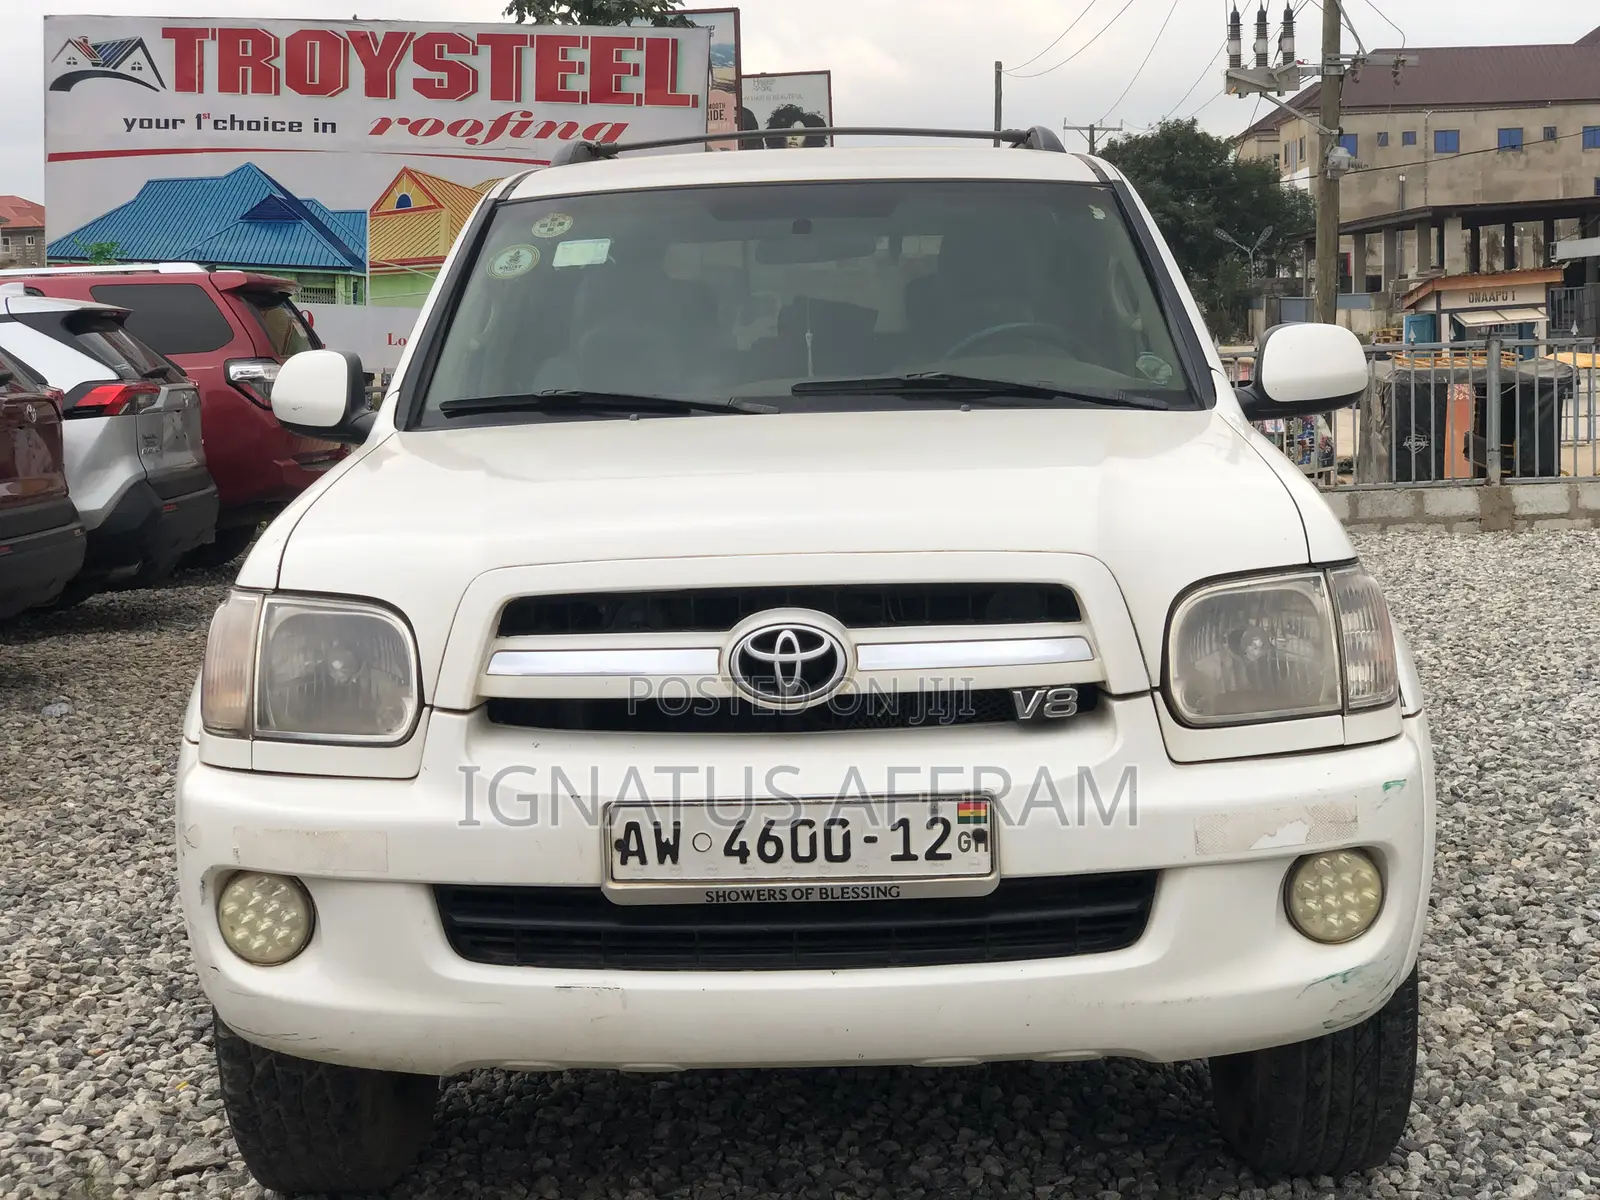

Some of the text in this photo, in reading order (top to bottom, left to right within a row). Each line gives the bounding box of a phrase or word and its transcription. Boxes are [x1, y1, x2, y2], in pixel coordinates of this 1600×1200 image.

[162, 27, 699, 108] TROYSTEEL
[708, 102, 726, 110] MOOTH
[123, 117, 186, 132] your
[213, 114, 303, 132] choice
[313, 118, 337, 133] in
[368, 110, 629, 145] roofing
[1012, 687, 1079, 720] V8
[620, 819, 681, 866] AW
[705, 885, 900, 903] SHOWERS OF BLESSING
